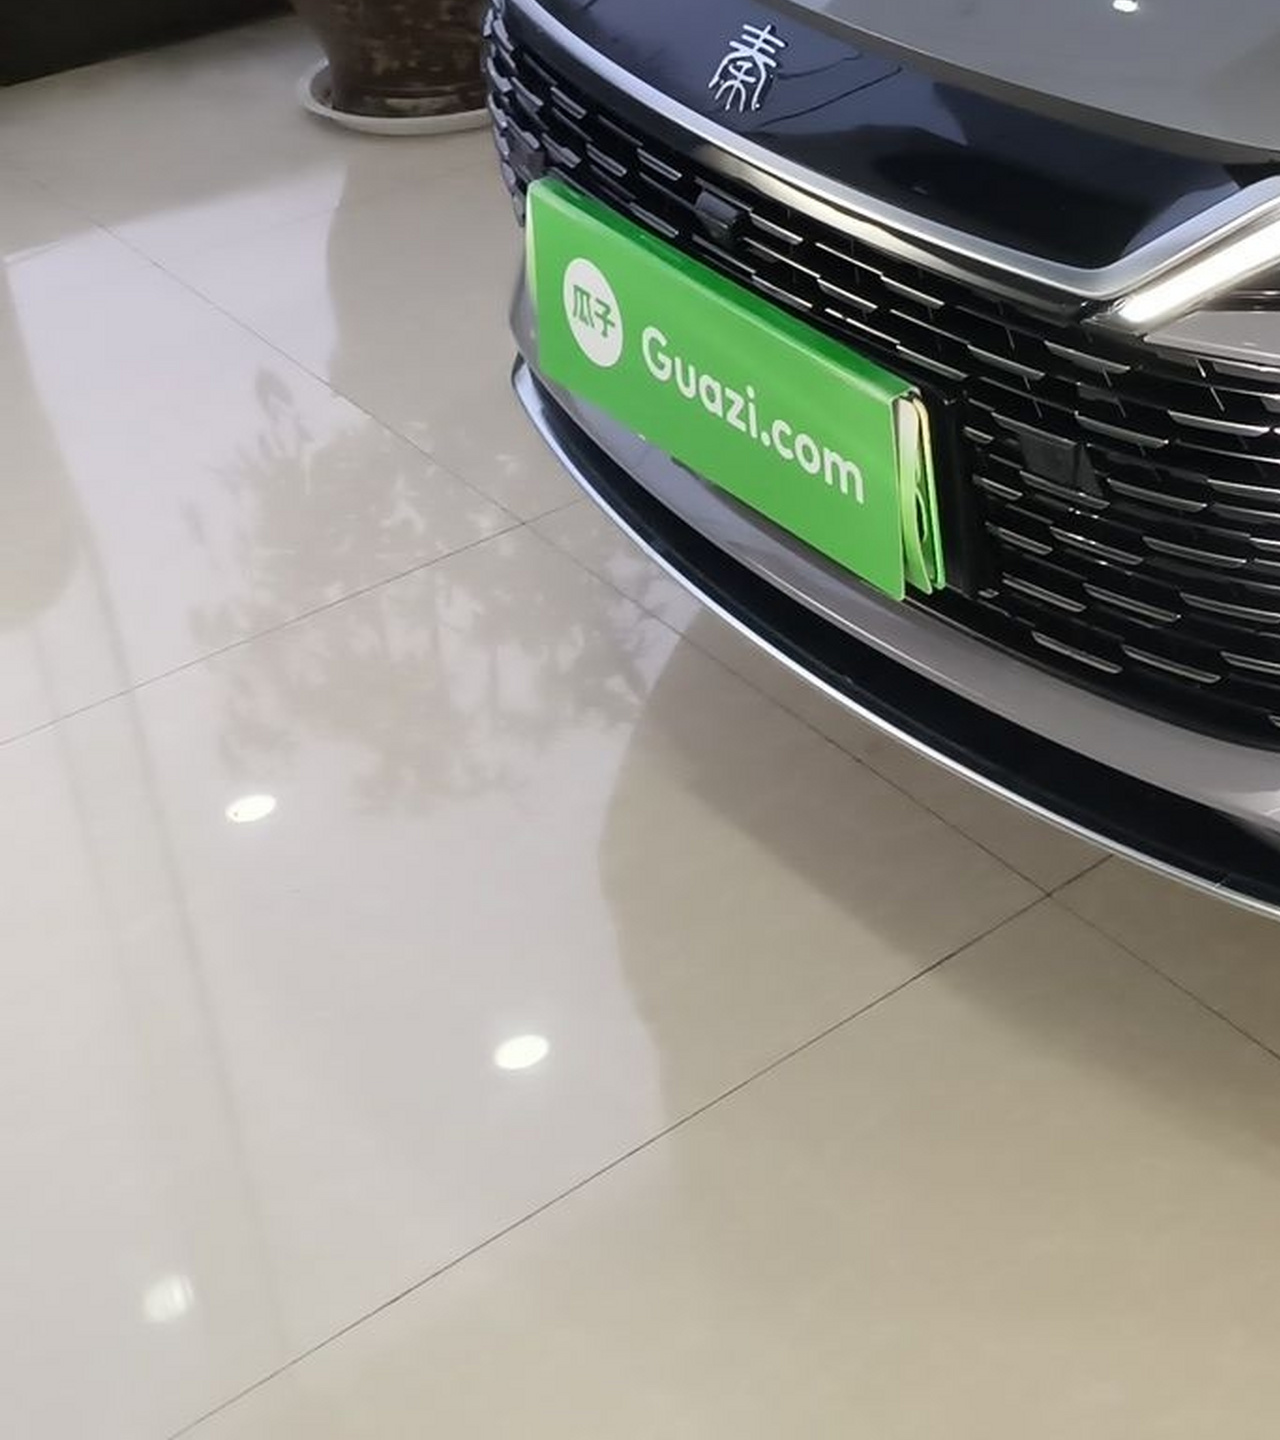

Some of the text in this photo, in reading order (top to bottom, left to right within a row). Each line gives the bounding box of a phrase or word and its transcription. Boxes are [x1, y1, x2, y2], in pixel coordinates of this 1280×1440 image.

[707, 23, 786, 112] 秦
[572, 284, 616, 338] 瓜子
[641, 325, 865, 505] Guazi.com
